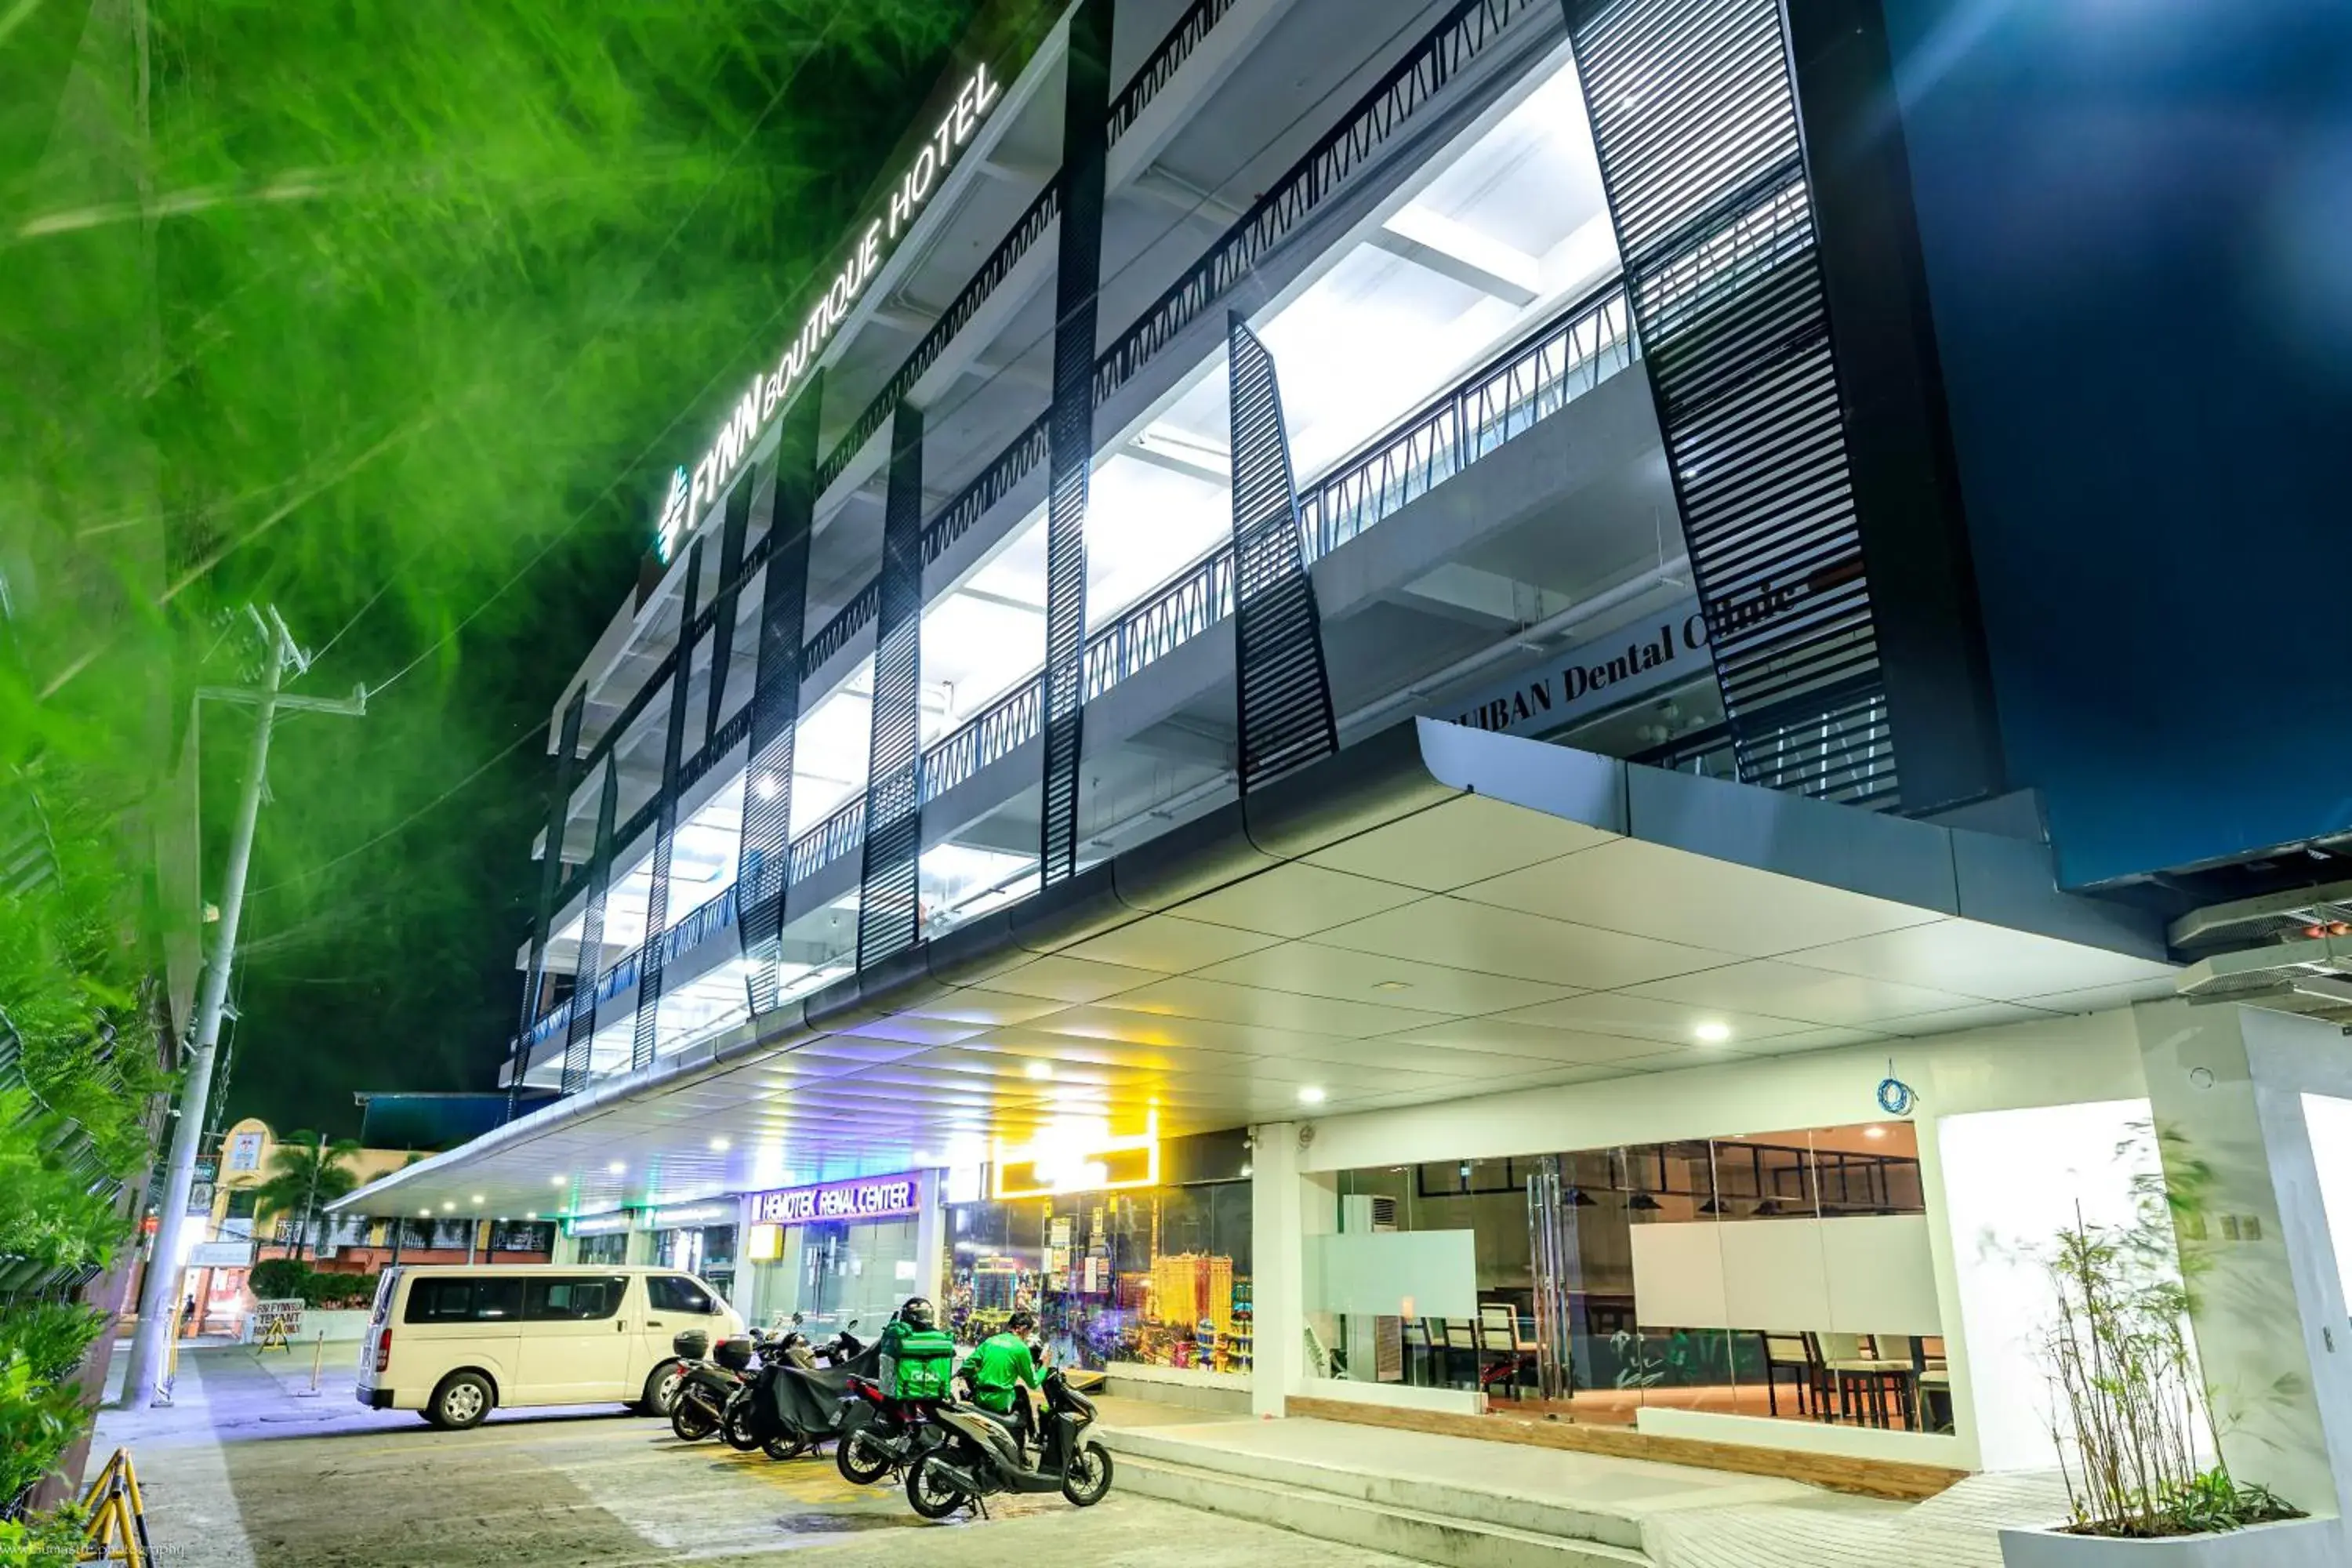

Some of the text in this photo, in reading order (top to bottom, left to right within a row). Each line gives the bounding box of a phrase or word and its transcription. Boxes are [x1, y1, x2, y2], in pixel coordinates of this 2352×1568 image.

[687, 62, 998, 531] FYNN BOUTIQUE HOTEL
[1562, 624, 1675, 703] Dental
[819, 1188, 858, 1215] RENAL
[858, 1181, 909, 1213] CENTER
[260, 1312, 301, 1324] TENANT
